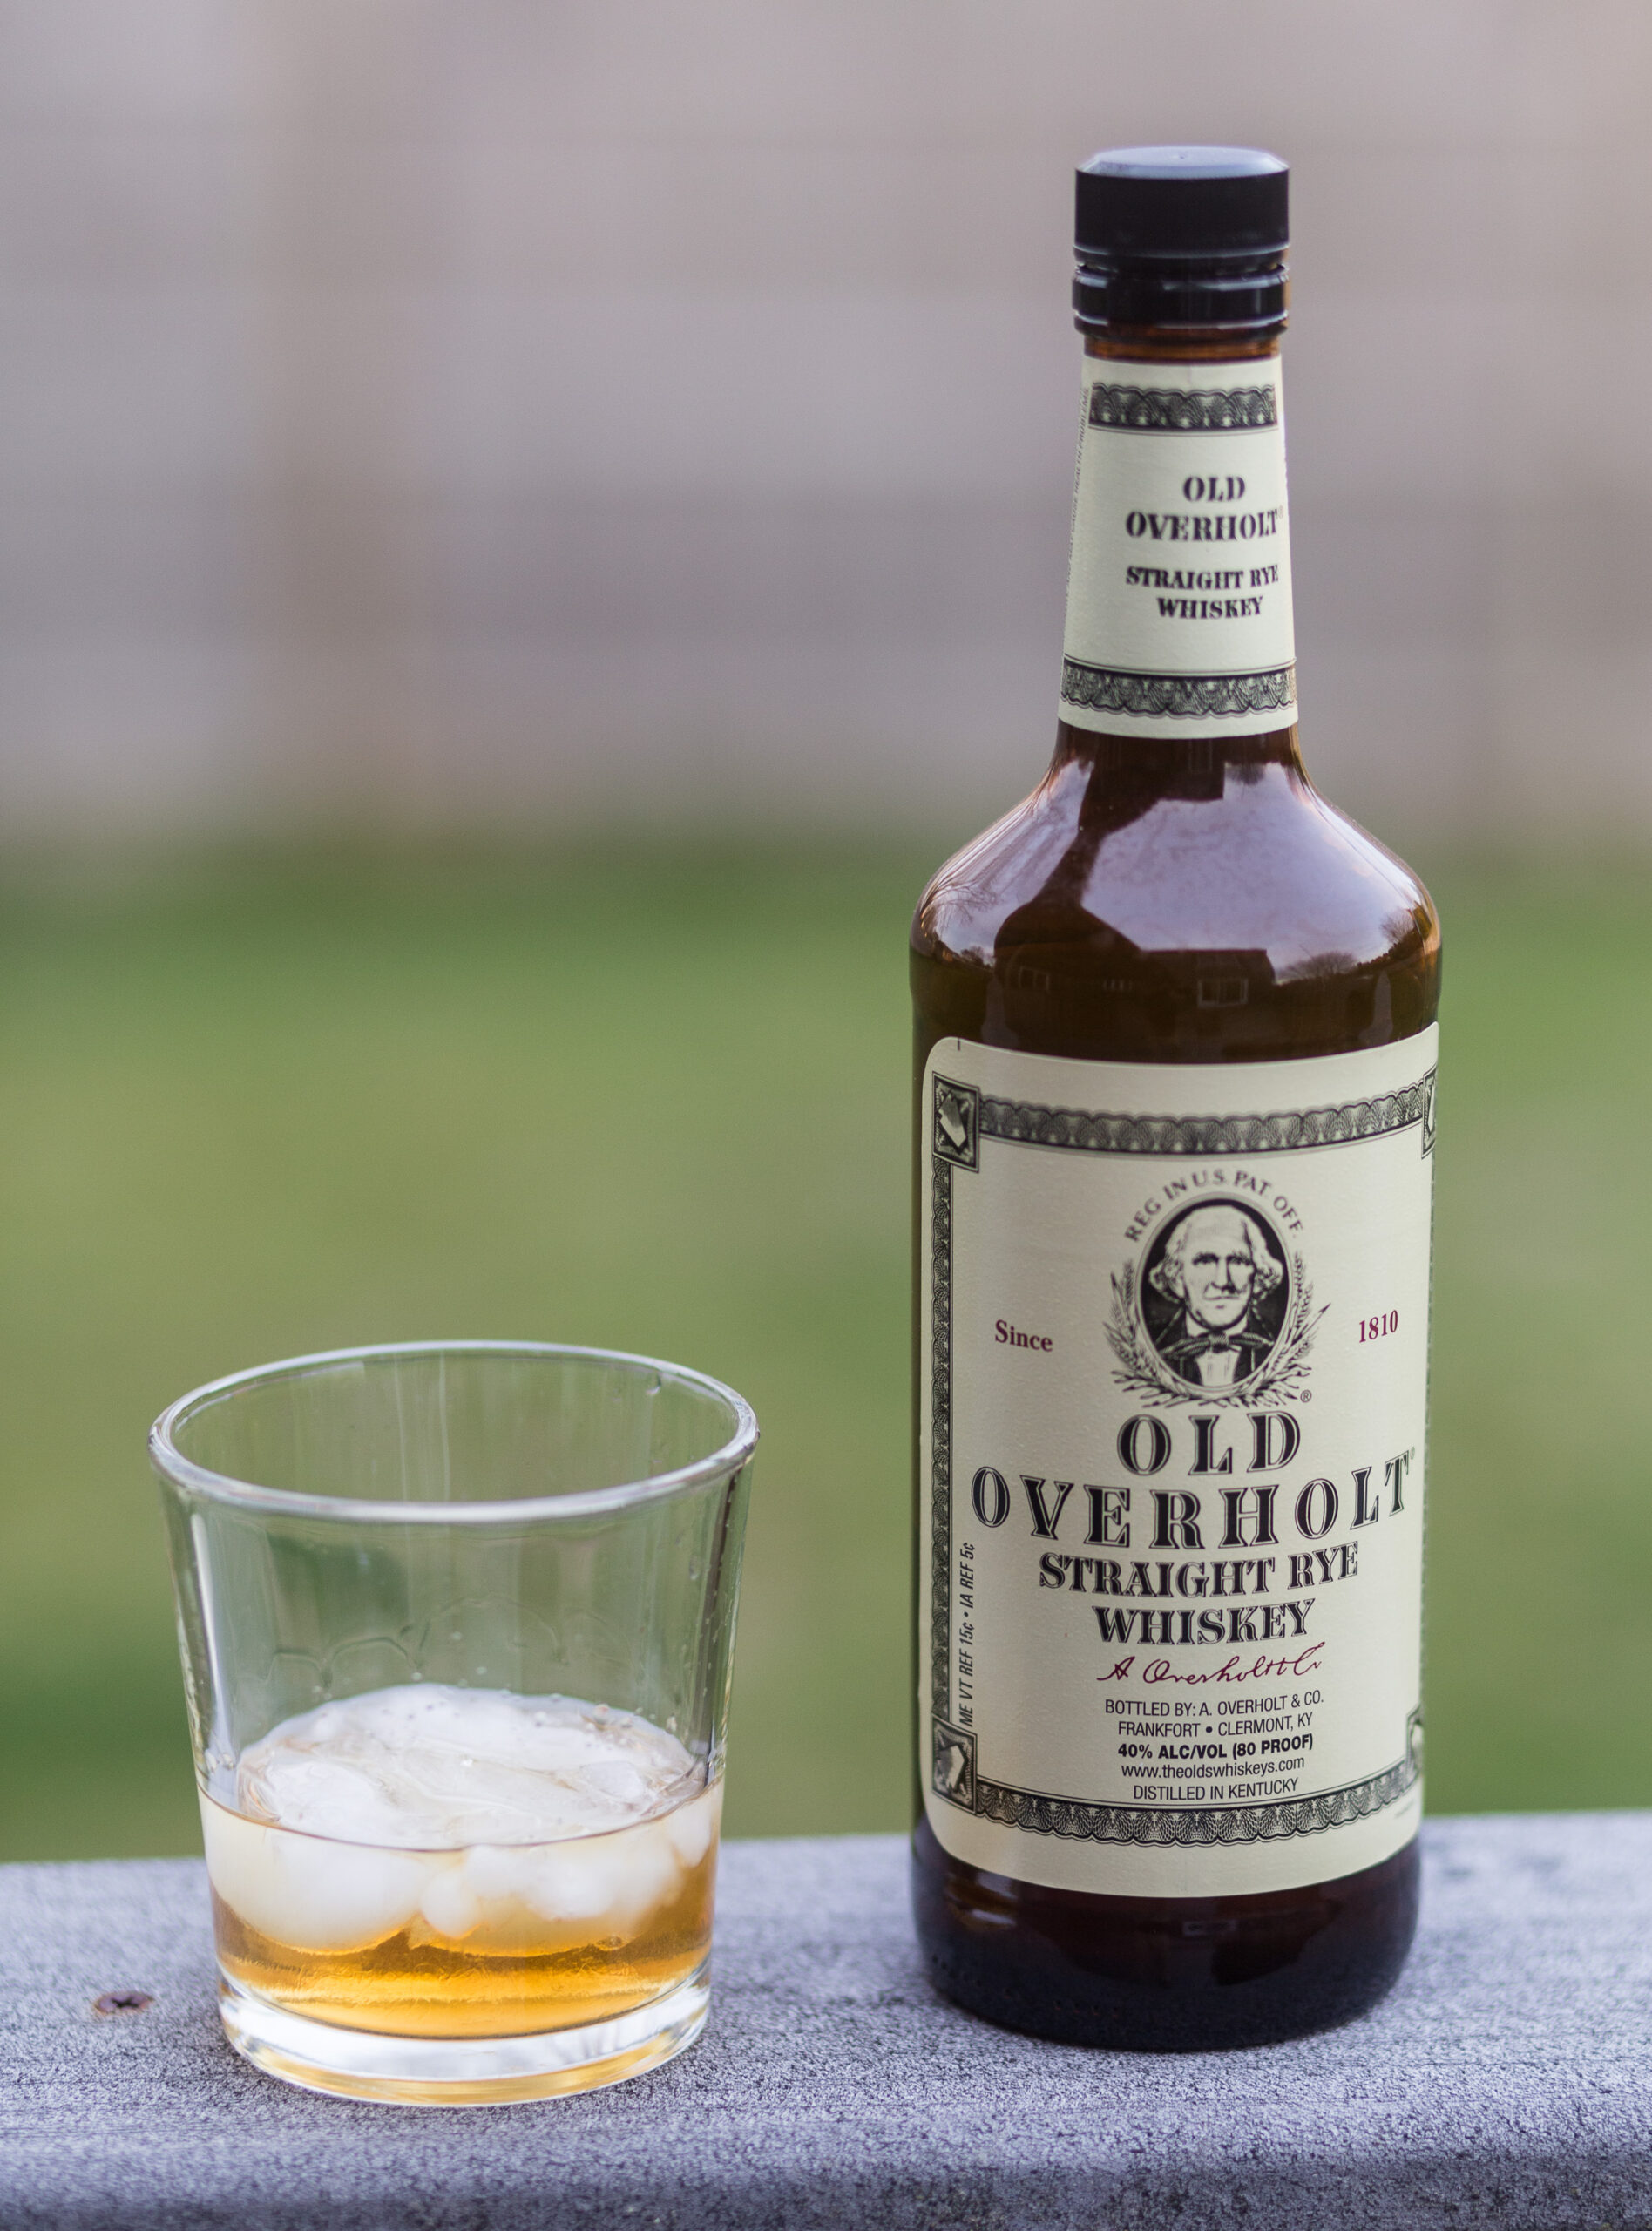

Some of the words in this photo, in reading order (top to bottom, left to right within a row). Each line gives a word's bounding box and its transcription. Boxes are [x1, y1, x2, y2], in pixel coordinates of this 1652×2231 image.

[1182, 476, 1246, 502] OLD
[1125, 508, 1278, 542] OVERHOLT
[1125, 565, 1244, 591] STRAIGHT
[1249, 564, 1279, 588] RYE
[1157, 595, 1263, 620] WHISKEY
[1162, 1177, 1188, 1201] IN
[994, 1319, 1053, 1353] Since
[1357, 1309, 1399, 1345] 1810
[1116, 1410, 1301, 1476] OLD
[971, 1449, 1410, 1550] OVERHOLT
[959, 1561, 974, 1590] REF
[1039, 1552, 1276, 1599] STRAIGHT
[1287, 1540, 1359, 1591] RYE
[959, 1593, 974, 1610] IA
[1092, 1598, 1316, 1646] WHISKEY
[958, 1648, 973, 1678] REF
[958, 1678, 973, 1705] VT
[1105, 1699, 1170, 1717] BOTTLED
[1175, 1702, 1196, 1717] BY:
[1198, 1702, 1213, 1717] A.
[1217, 1695, 1288, 1716] OVERHOLT
[1290, 1693, 1301, 1708] &
[1303, 1689, 1324, 1706] CO.
[958, 1703, 973, 1727] ME
[1118, 1720, 1201, 1738] FRANKFORT
[1217, 1715, 1294, 1737] CLERMONT,
[1297, 1711, 1313, 1728] KY
[1118, 1743, 1153, 1759] 40%
[1157, 1744, 1227, 1760] ALC/VOL
[1232, 1742, 1256, 1760] (80
[1261, 1733, 1313, 1755] PROOF)
[1121, 1757, 1304, 1778] www.theoldswhiskeys.com
[1134, 1785, 1206, 1800] DISTILLED
[1210, 1785, 1224, 1800] IN
[1229, 1777, 1299, 1800] KENTUCKY
